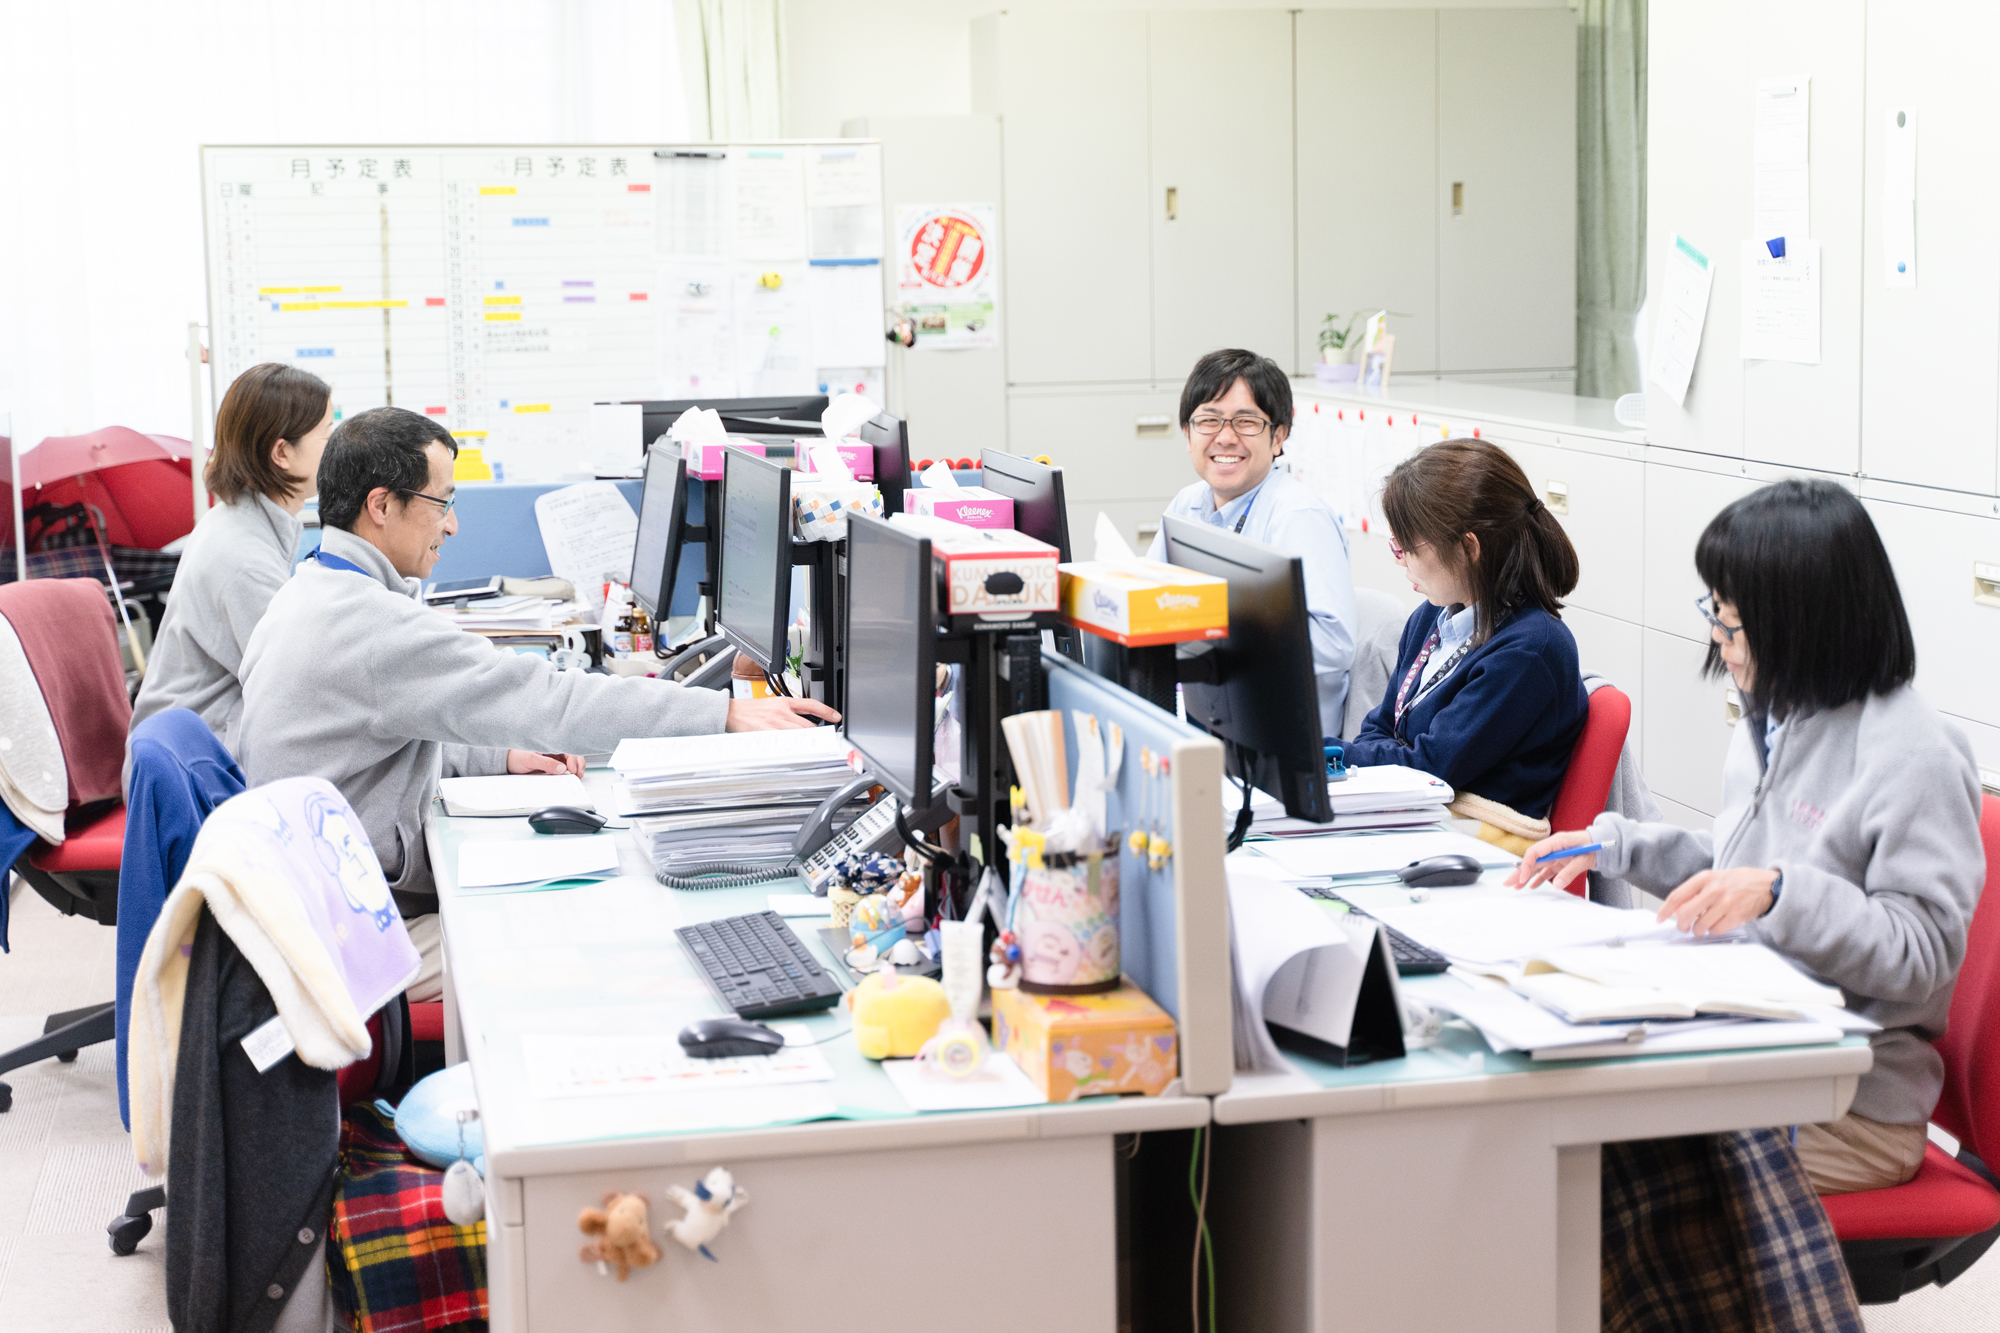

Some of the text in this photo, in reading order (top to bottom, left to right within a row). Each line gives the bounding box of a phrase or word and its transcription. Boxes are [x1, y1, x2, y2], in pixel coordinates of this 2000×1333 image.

[291, 157, 413, 180] 月予定表
[956, 505, 993, 520] Kleenex
[951, 564, 1057, 582] KUMOTO
[951, 583, 1057, 606] DAUKI
